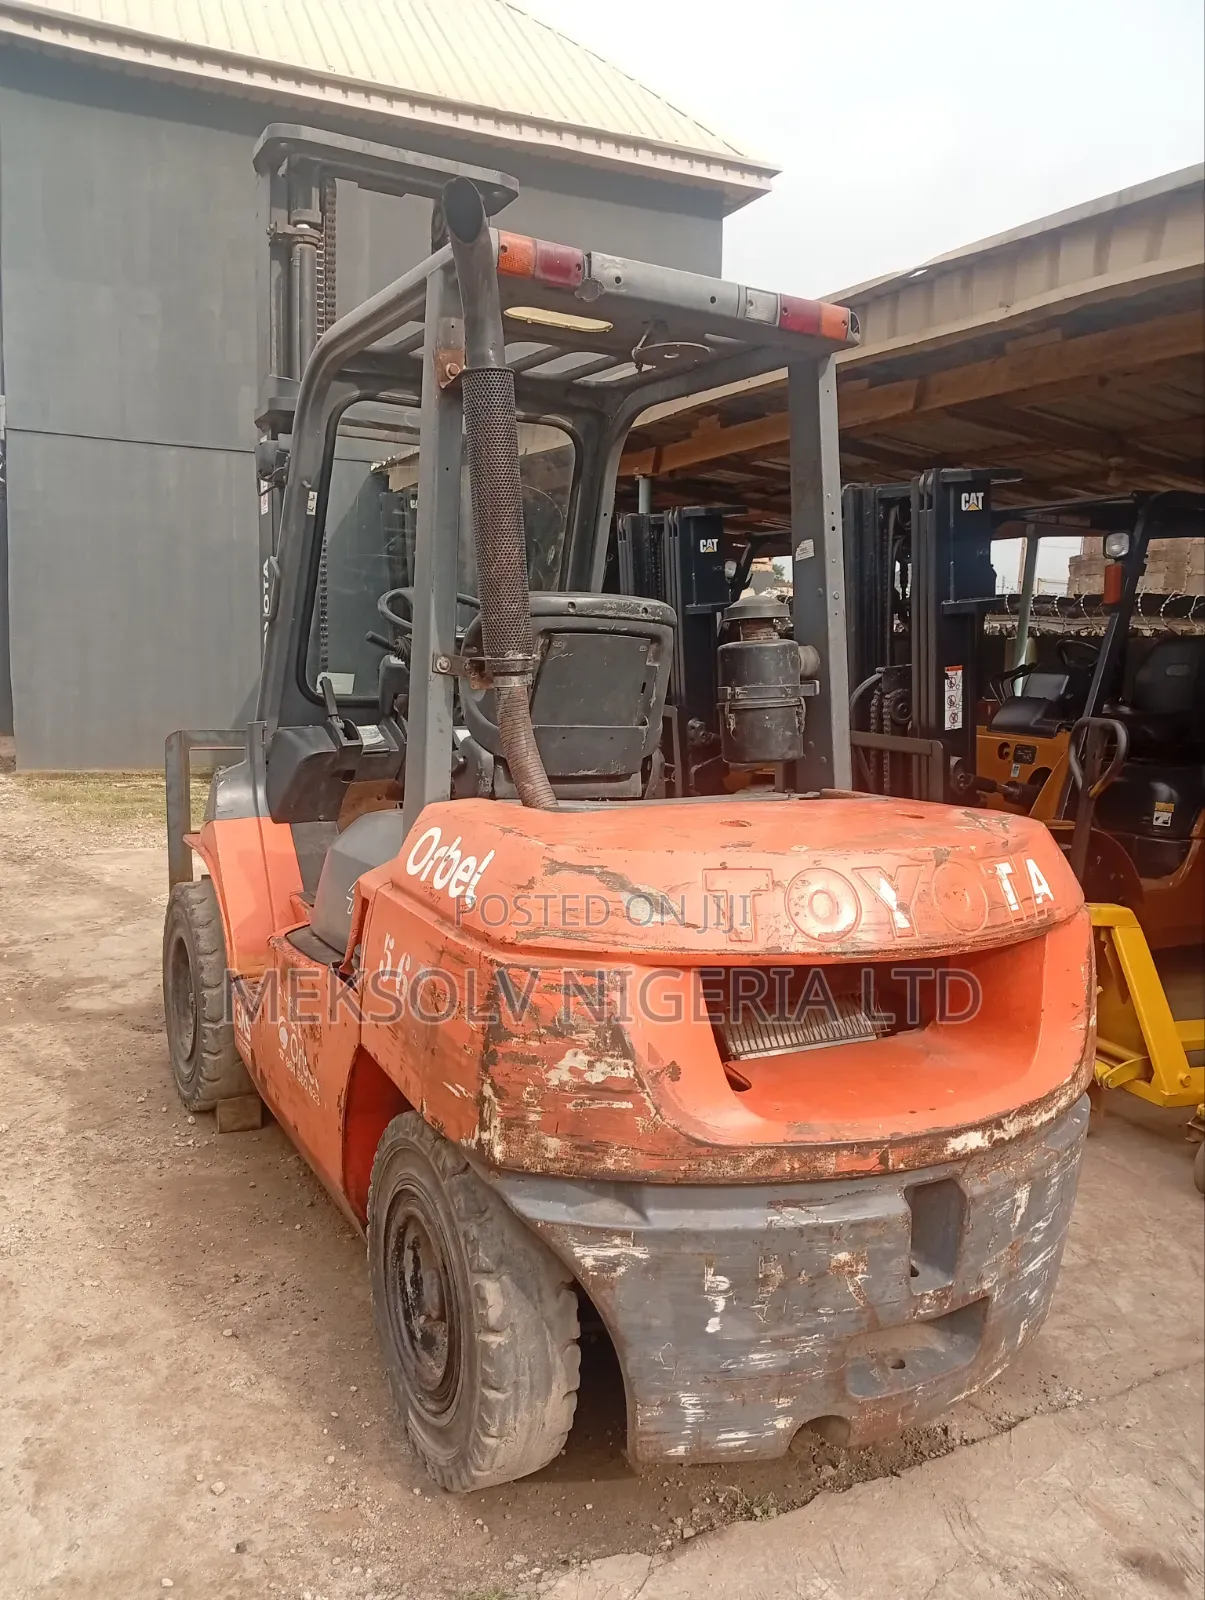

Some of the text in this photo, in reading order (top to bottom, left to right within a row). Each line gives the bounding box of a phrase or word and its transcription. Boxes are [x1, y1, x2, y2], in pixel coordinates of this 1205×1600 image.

[961, 492, 984, 511] CAT
[700, 539, 719, 553] CAT
[702, 853, 1055, 943] TOYOTA
